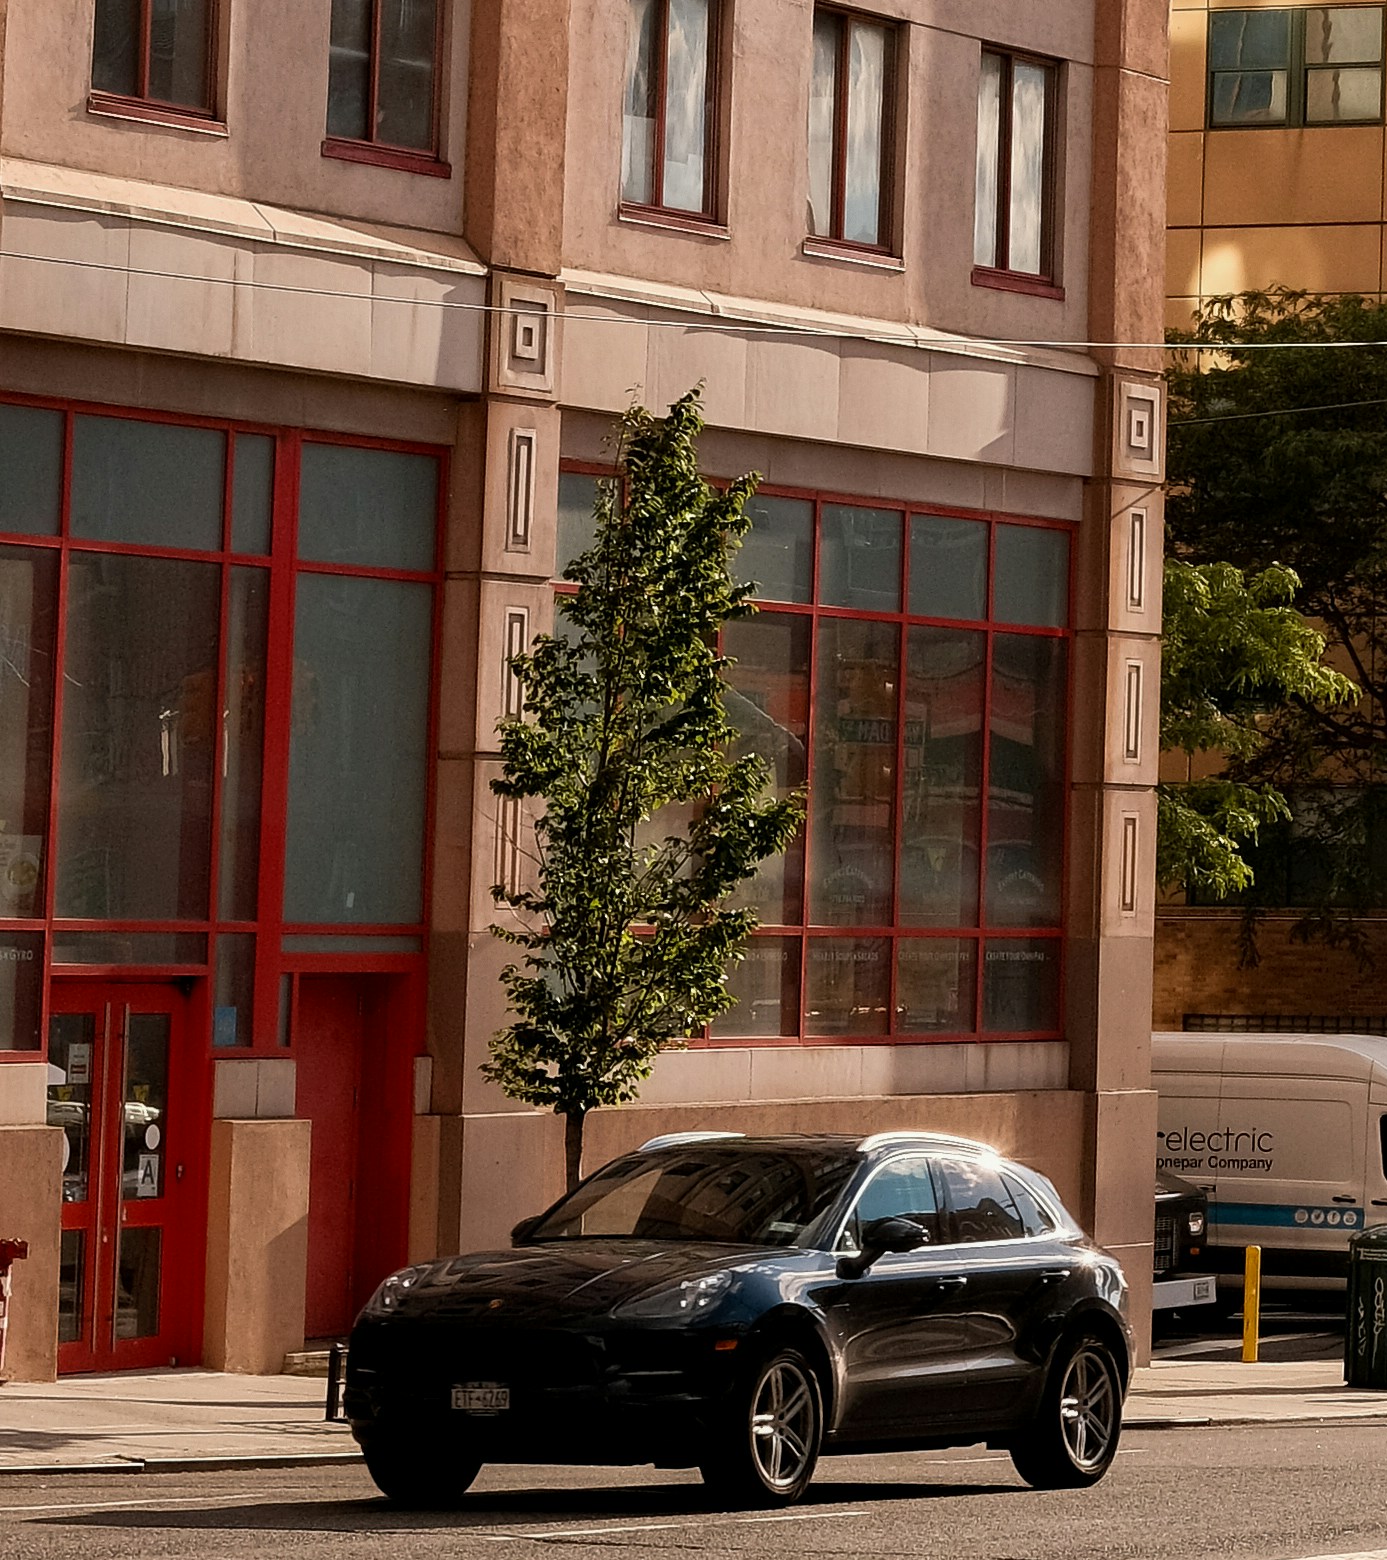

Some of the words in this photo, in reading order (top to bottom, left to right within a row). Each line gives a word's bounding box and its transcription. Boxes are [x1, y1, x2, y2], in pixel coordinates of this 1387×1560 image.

[1165, 1126, 1273, 1153] electric
[141, 1159, 155, 1185] A
[1207, 1155, 1273, 1172] Company
